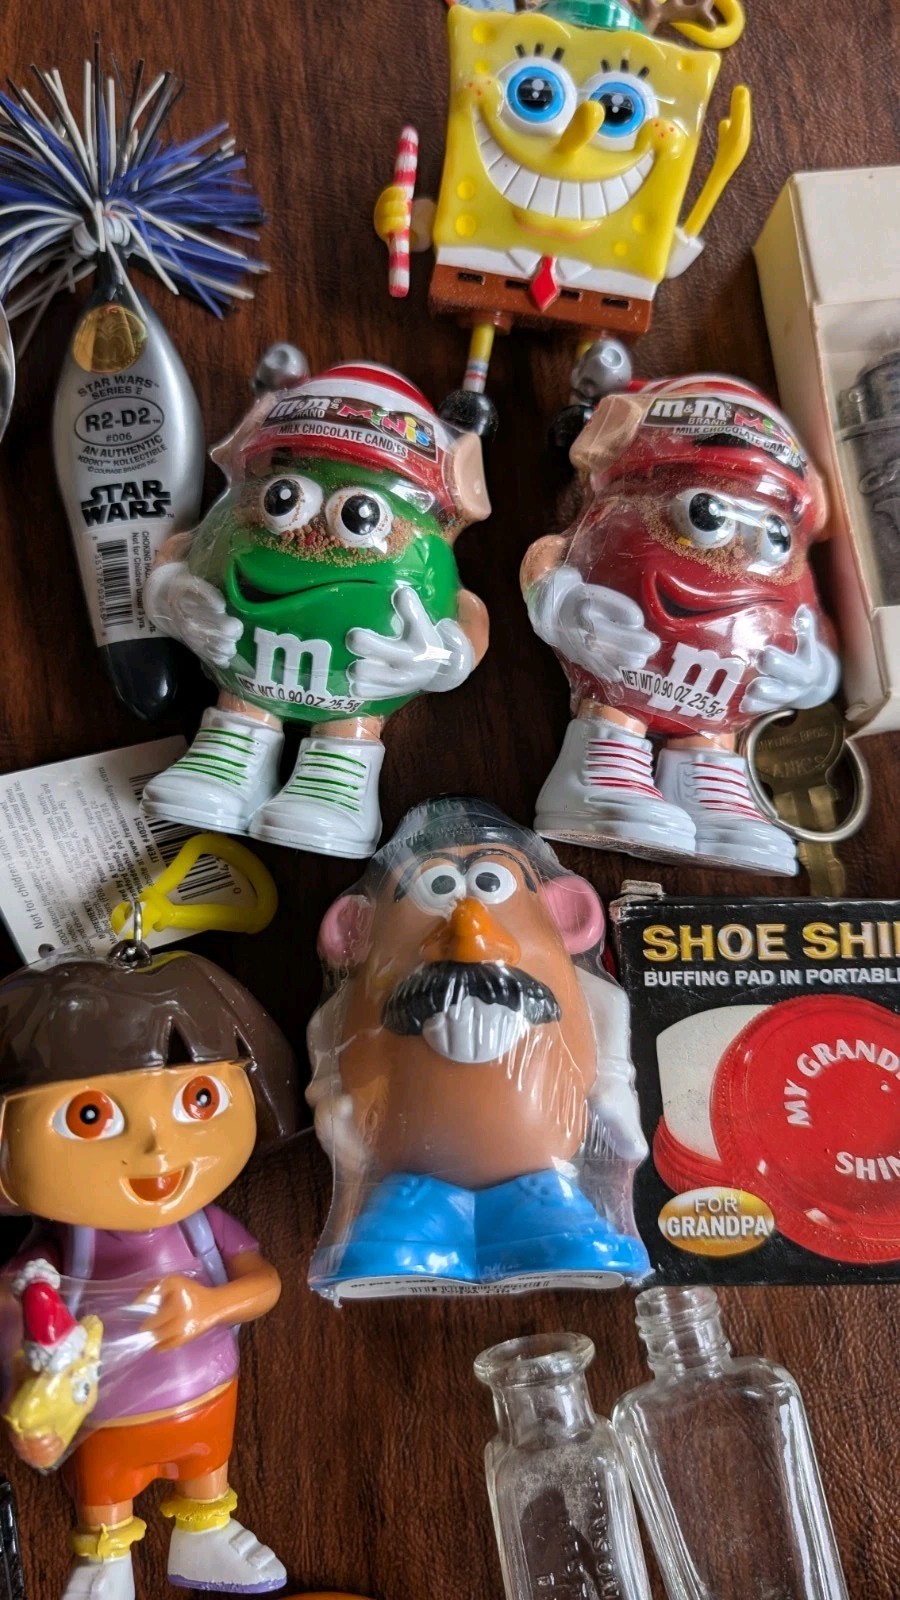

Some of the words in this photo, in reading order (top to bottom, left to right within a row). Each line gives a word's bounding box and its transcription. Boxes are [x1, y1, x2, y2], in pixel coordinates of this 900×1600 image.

[78, 377, 110, 397] STAR
[92, 385, 132, 399] SERIES
[687, 417, 727, 425] BRAND
[106, 432, 132, 443] #006
[280, 425, 299, 434] MILK
[302, 424, 362, 441] CHOCOLATE
[703, 426, 760, 445] CHOCOLATE
[82, 445, 99, 456] AN
[100, 434, 163, 457] AUTHENTIC
[113, 443, 168, 467] KOLLECTIBLE
[81, 479, 171, 508] STAR
[81, 499, 172, 527] WARS
[132, 532, 140, 544] Not
[142, 531, 152, 562] CHOKING
[134, 557, 142, 587] Children
[136, 589, 144, 609] Under
[258, 686, 275, 698] WT
[277, 688, 302, 703] 0.90
[305, 694, 326, 707] OZ
[622, 669, 638, 686] NET
[639, 673, 653, 691] WT
[653, 678, 673, 698] 0.90
[674, 685, 692, 703] OZ
[687, 693, 725, 718] 25.5g
[133, 817, 150, 842] #40251
[111, 851, 125, 871] Candy
[145, 845, 159, 862] ITEM
[5, 863, 29, 897] children
[139, 866, 154, 886] bsite
[121, 873, 139, 902] rankford
[22, 898, 35, 911] for
[30, 914, 44, 928] Not
[56, 929, 69, 945] 2004
[642, 923, 790, 962] SHOE
[643, 970, 730, 987] BUFFING
[735, 969, 777, 985] PAD
[781, 969, 801, 985] IN
[796, 1038, 900, 1080] GRAND
[784, 1078, 811, 1127] MY
[694, 1195, 738, 1213] FOR
[666, 1216, 770, 1237] GRANDPA
